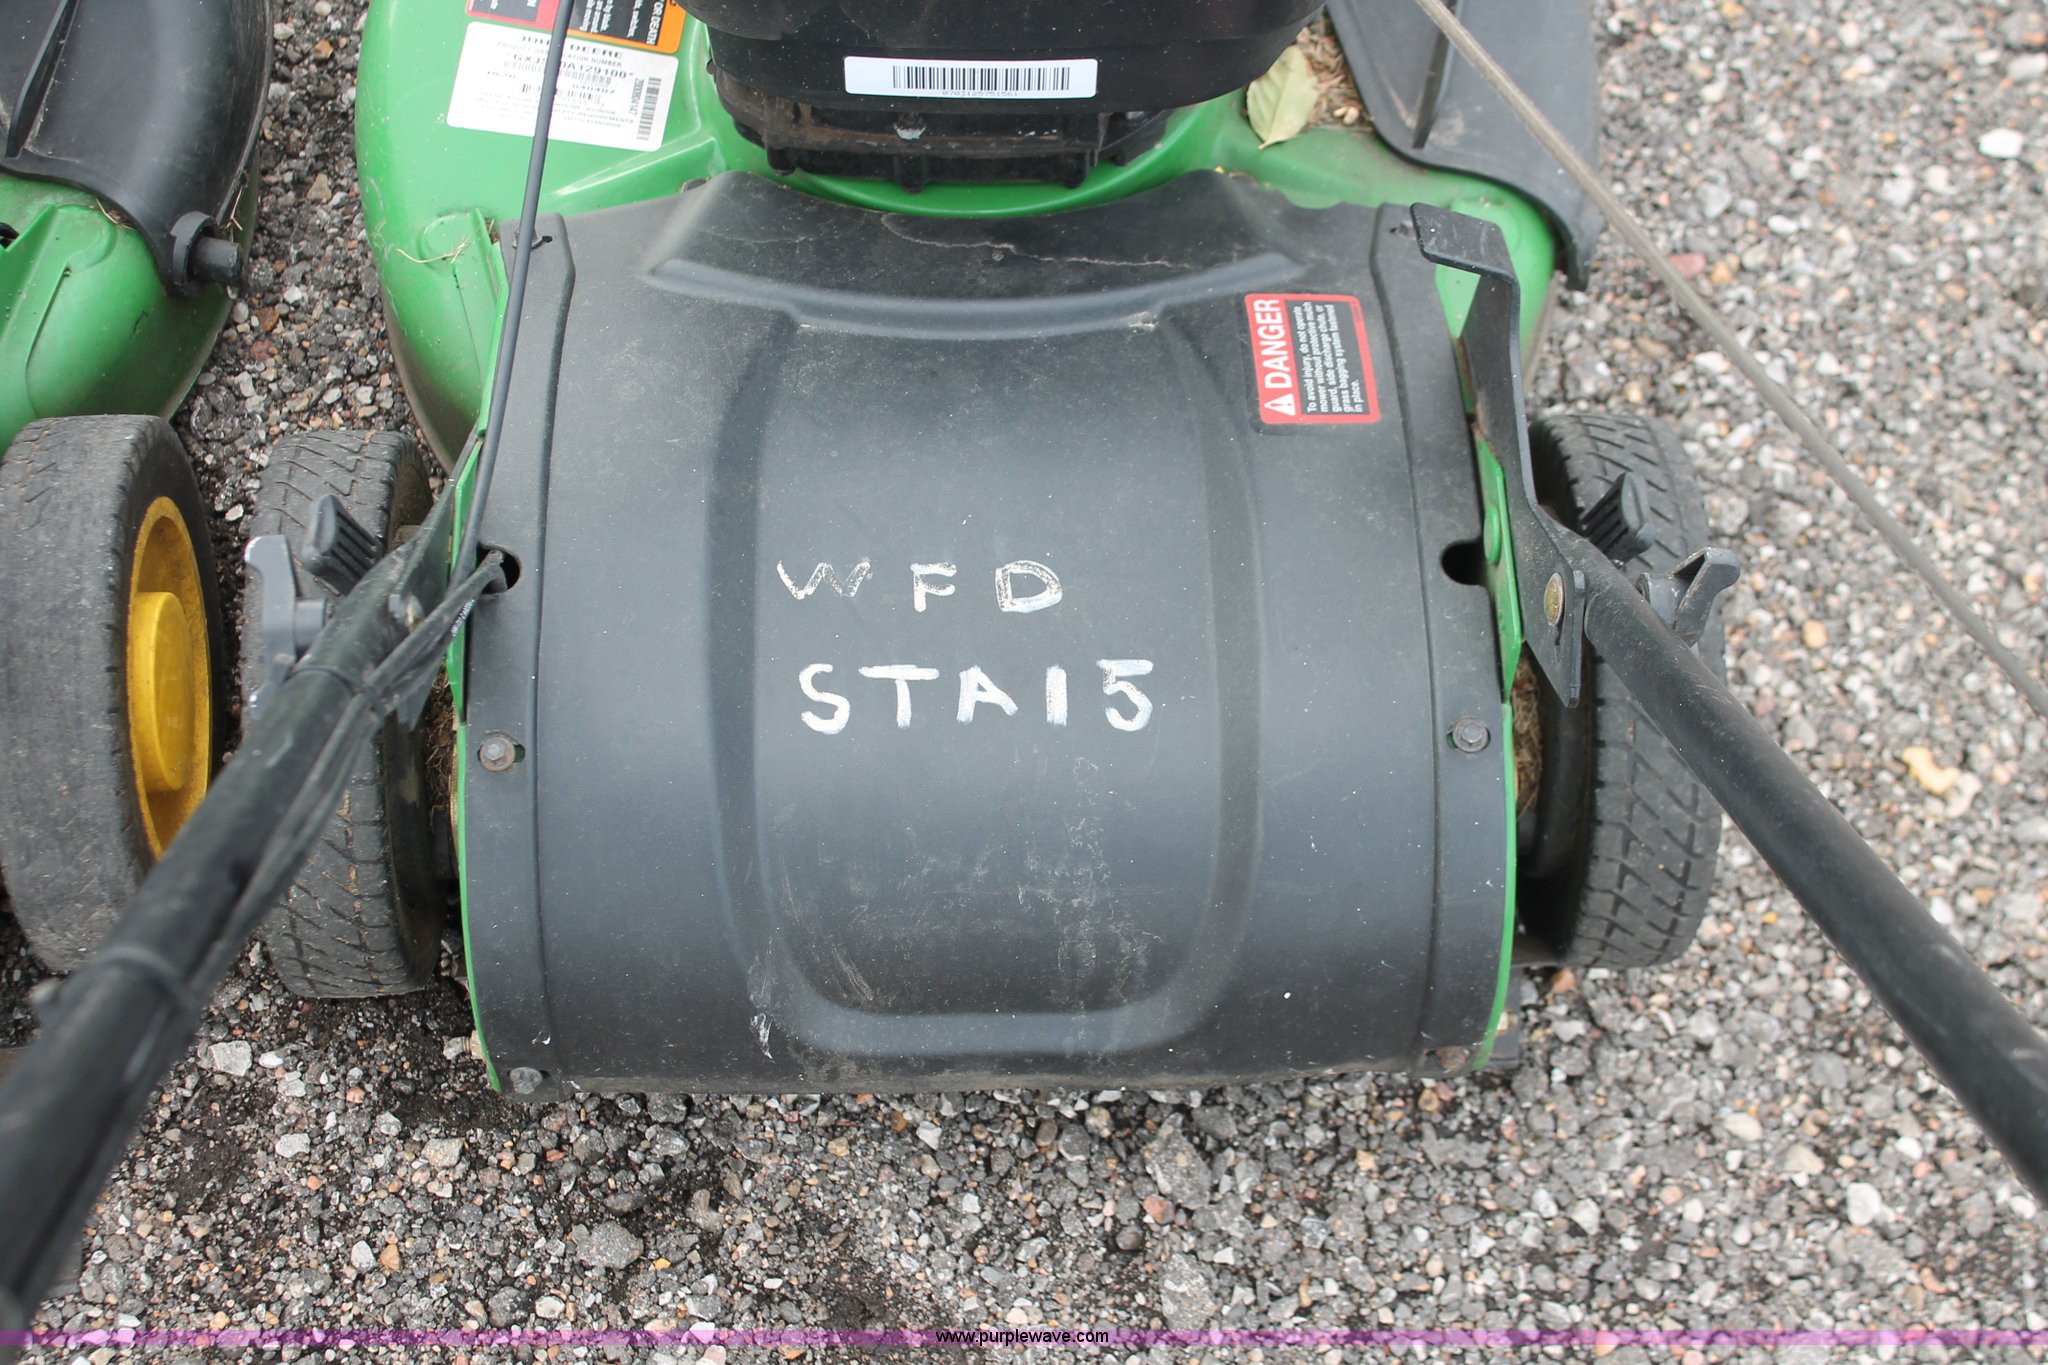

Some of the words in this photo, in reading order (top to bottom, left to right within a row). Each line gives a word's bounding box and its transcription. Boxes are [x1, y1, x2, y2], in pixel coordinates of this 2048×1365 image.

[646, 16, 661, 44] DEATH
[570, 43, 623, 60] DEERE
[591, 55, 622, 68] NUMBER
[1293, 306, 1306, 330] operate
[1302, 302, 1314, 321] mulch
[1324, 304, 1339, 331] fastened
[1253, 299, 1293, 389] DANGER
[1297, 331, 1307, 343] not
[1299, 343, 1309, 353] do
[1308, 321, 1323, 356] protective
[1331, 332, 1345, 357] system
[1321, 333, 1335, 368] discharge
[1313, 356, 1325, 385] without
[1325, 369, 1336, 386] side
[1336, 357, 1349, 389] bagging
[1304, 379, 1317, 401] avoid
[1318, 386, 1328, 412] mower
[1340, 389, 1354, 412] grass
[1307, 402, 1317, 412] To
[1353, 403, 1363, 412] in
